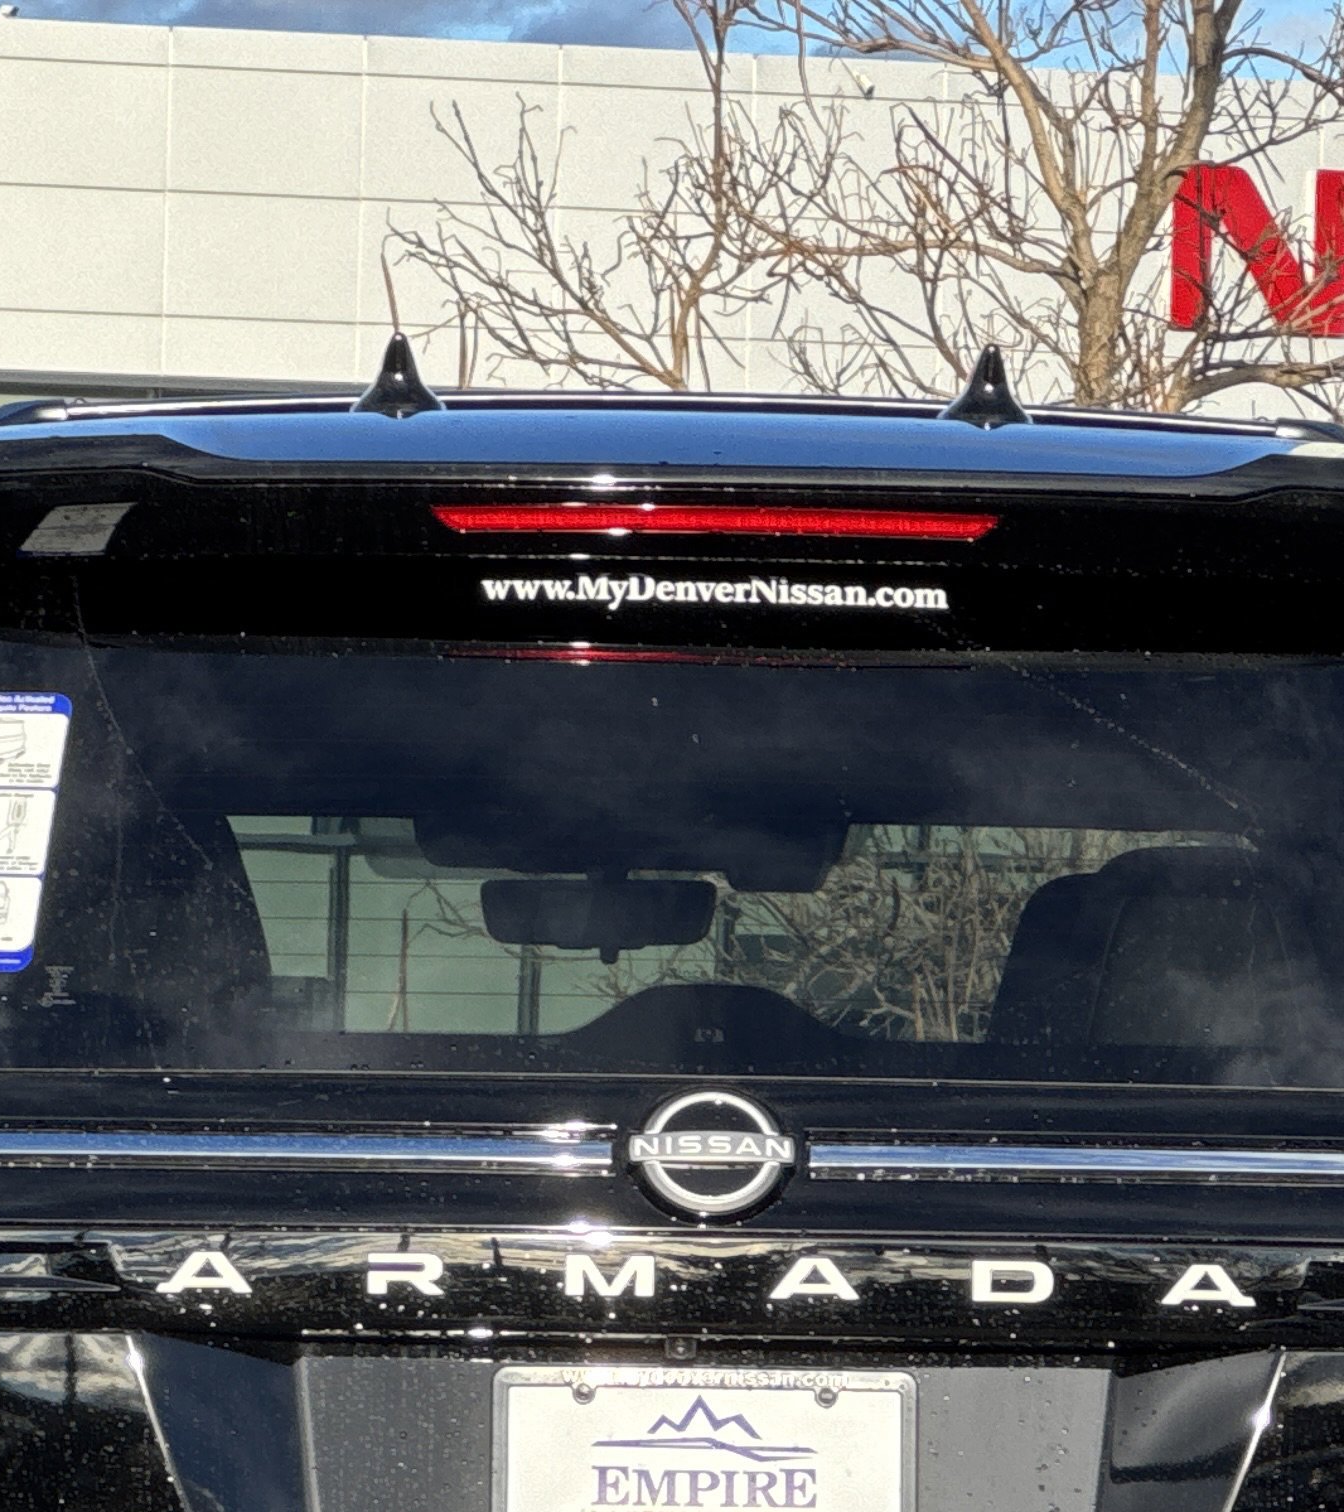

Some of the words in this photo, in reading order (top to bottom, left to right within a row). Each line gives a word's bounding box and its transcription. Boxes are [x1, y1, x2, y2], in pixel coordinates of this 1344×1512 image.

[482, 572, 949, 611] www.MyDenverNissan.com
[633, 1134, 791, 1159] NISSAN
[156, 1250, 1257, 1307] ARMADA
[591, 1466, 817, 1509] EMPIRE
